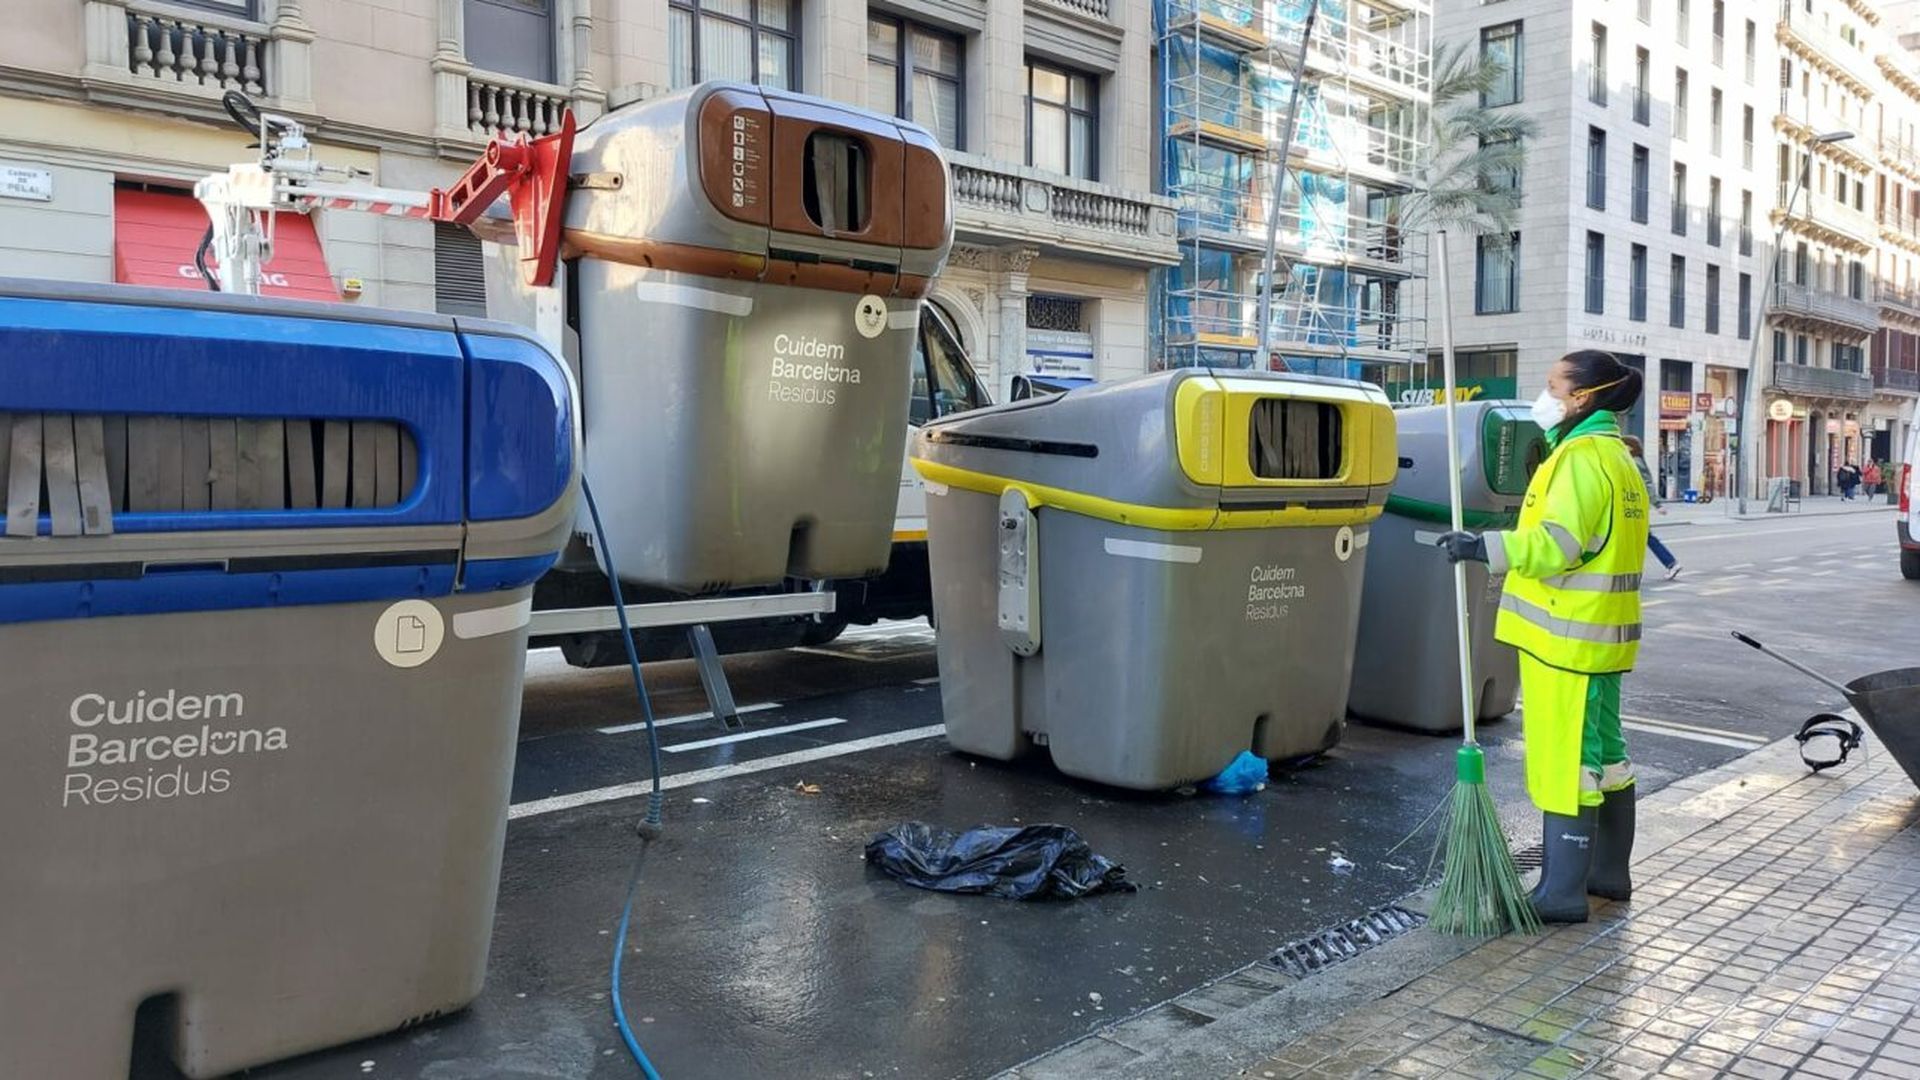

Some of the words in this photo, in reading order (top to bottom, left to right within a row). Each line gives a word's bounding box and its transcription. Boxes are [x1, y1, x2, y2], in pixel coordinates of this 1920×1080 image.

[773, 334, 845, 360] Cuidem
[771, 357, 861, 385] Barcelona
[768, 381, 836, 405] Residus
[1250, 564, 1295, 582] Cuidem
[1248, 583, 1305, 602] Barcelona
[1246, 602, 1289, 621] Residus
[69, 689, 244, 727] Cuidem
[67, 725, 289, 768] Barcelona
[62, 764, 231, 808] Residus
